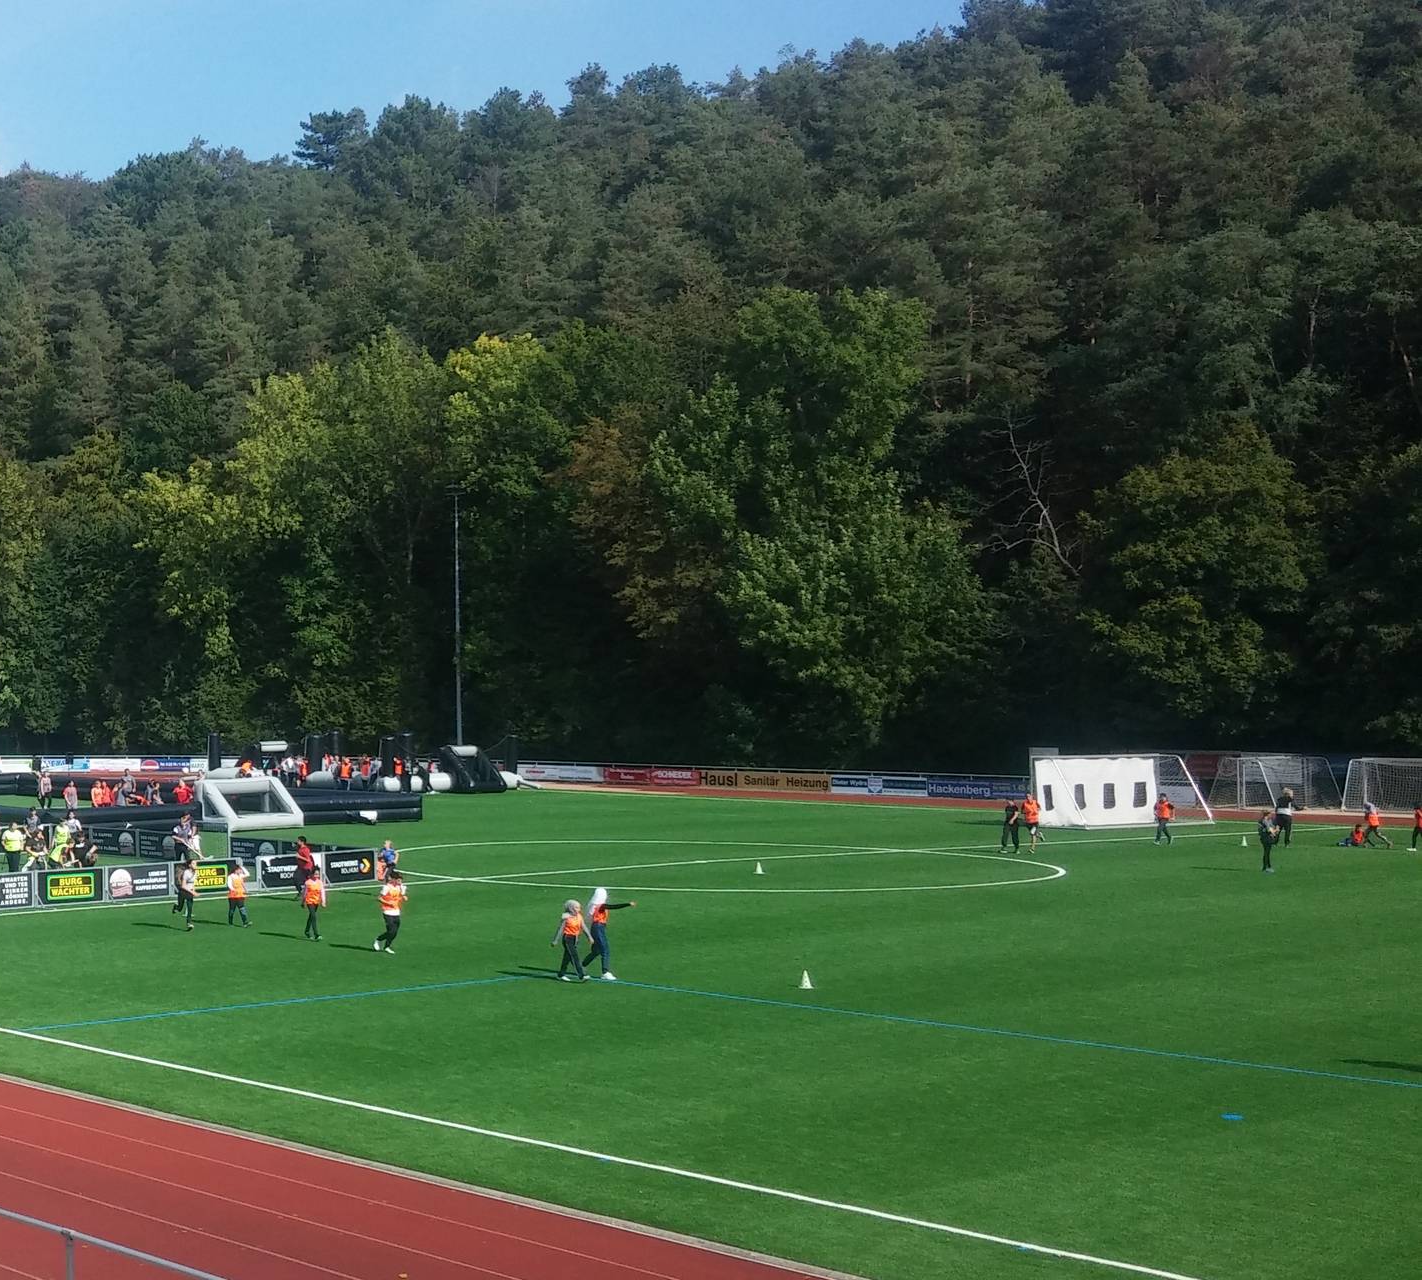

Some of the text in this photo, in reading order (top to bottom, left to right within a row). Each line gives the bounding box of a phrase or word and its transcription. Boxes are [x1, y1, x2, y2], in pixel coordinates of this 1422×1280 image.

[699, 772, 737, 787] Hausl
[744, 775, 778, 786] Sanitär
[786, 777, 829, 791] Heizung
[928, 783, 991, 797] Hackenberg
[195, 868, 217, 876] BURG
[59, 877, 83, 886] BURG
[2, 887, 28, 895] TRINKEN
